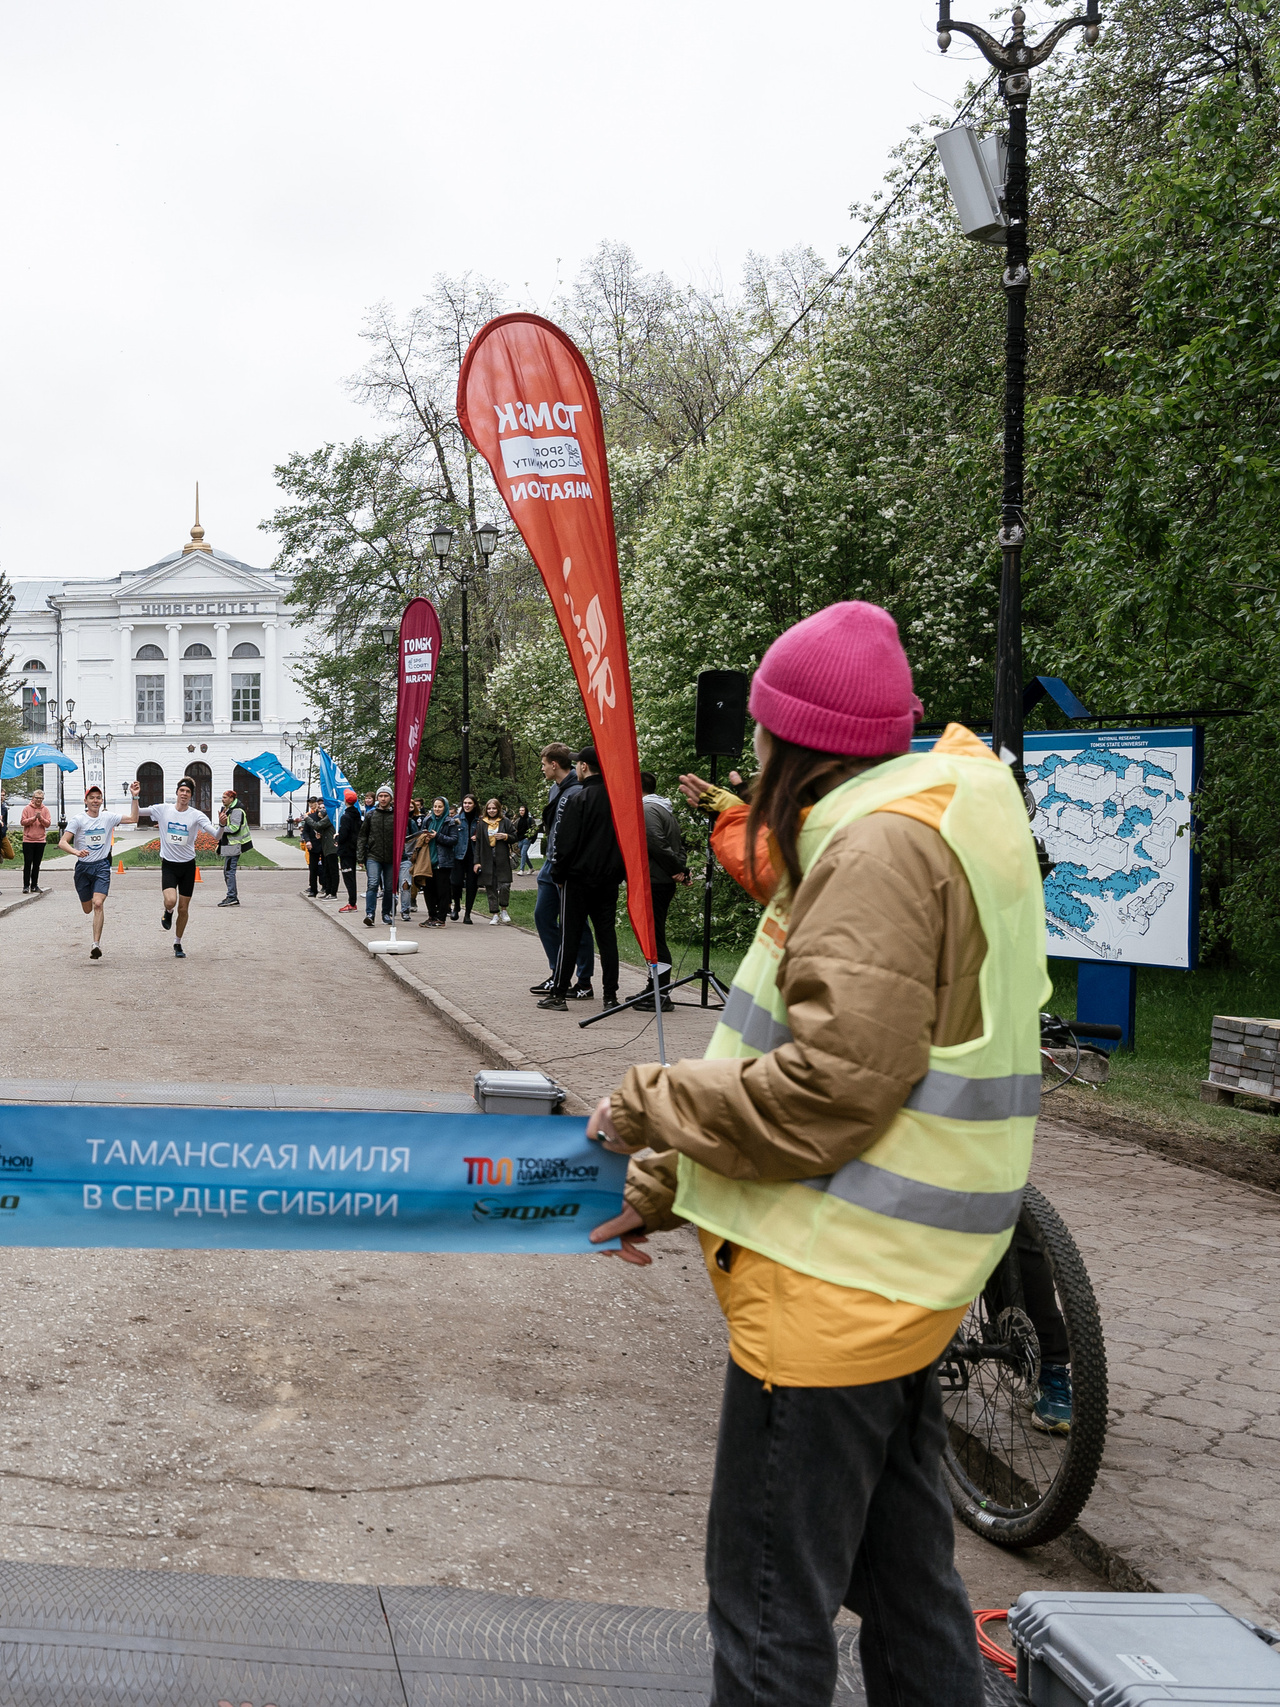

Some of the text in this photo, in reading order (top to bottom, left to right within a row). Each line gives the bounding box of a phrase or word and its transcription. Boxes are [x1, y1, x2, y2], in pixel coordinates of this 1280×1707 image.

[141, 602, 260, 616] УНИВЕРСИТЕТ
[87, 770, 102, 782] 1878
[86, 1139, 410, 1173] ТАМАНСКАЯ МИЛЯ
[516, 1157, 569, 1169] TOMSK
[517, 1166, 599, 1181] MARATHON
[83, 1184, 398, 1218] В СЕРДЦЕ СИБИРИ
[488, 1203, 581, 1220] ЭФКО
